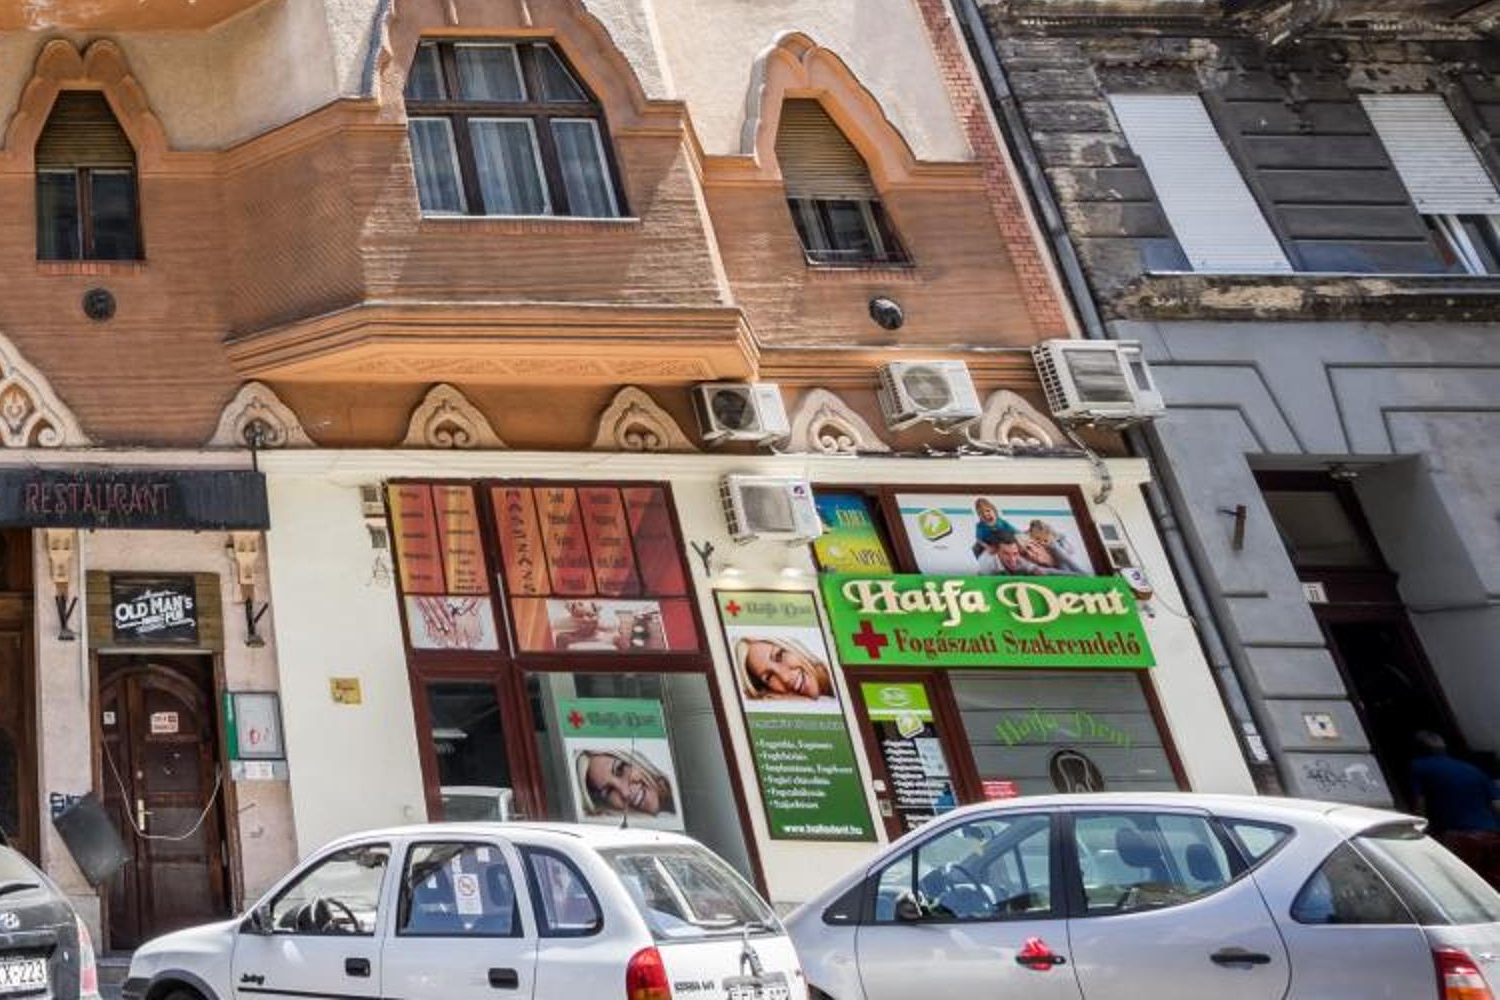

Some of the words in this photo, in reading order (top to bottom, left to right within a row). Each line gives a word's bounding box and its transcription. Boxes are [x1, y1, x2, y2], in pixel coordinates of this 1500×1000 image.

[25, 482, 170, 513] RESTAURANT
[115, 602, 148, 621] OLD
[842, 580, 990, 627] Haifa
[996, 581, 1130, 623] Dent
[893, 628, 998, 659] Fogászati
[1002, 629, 1142, 657] Szakrendelő
